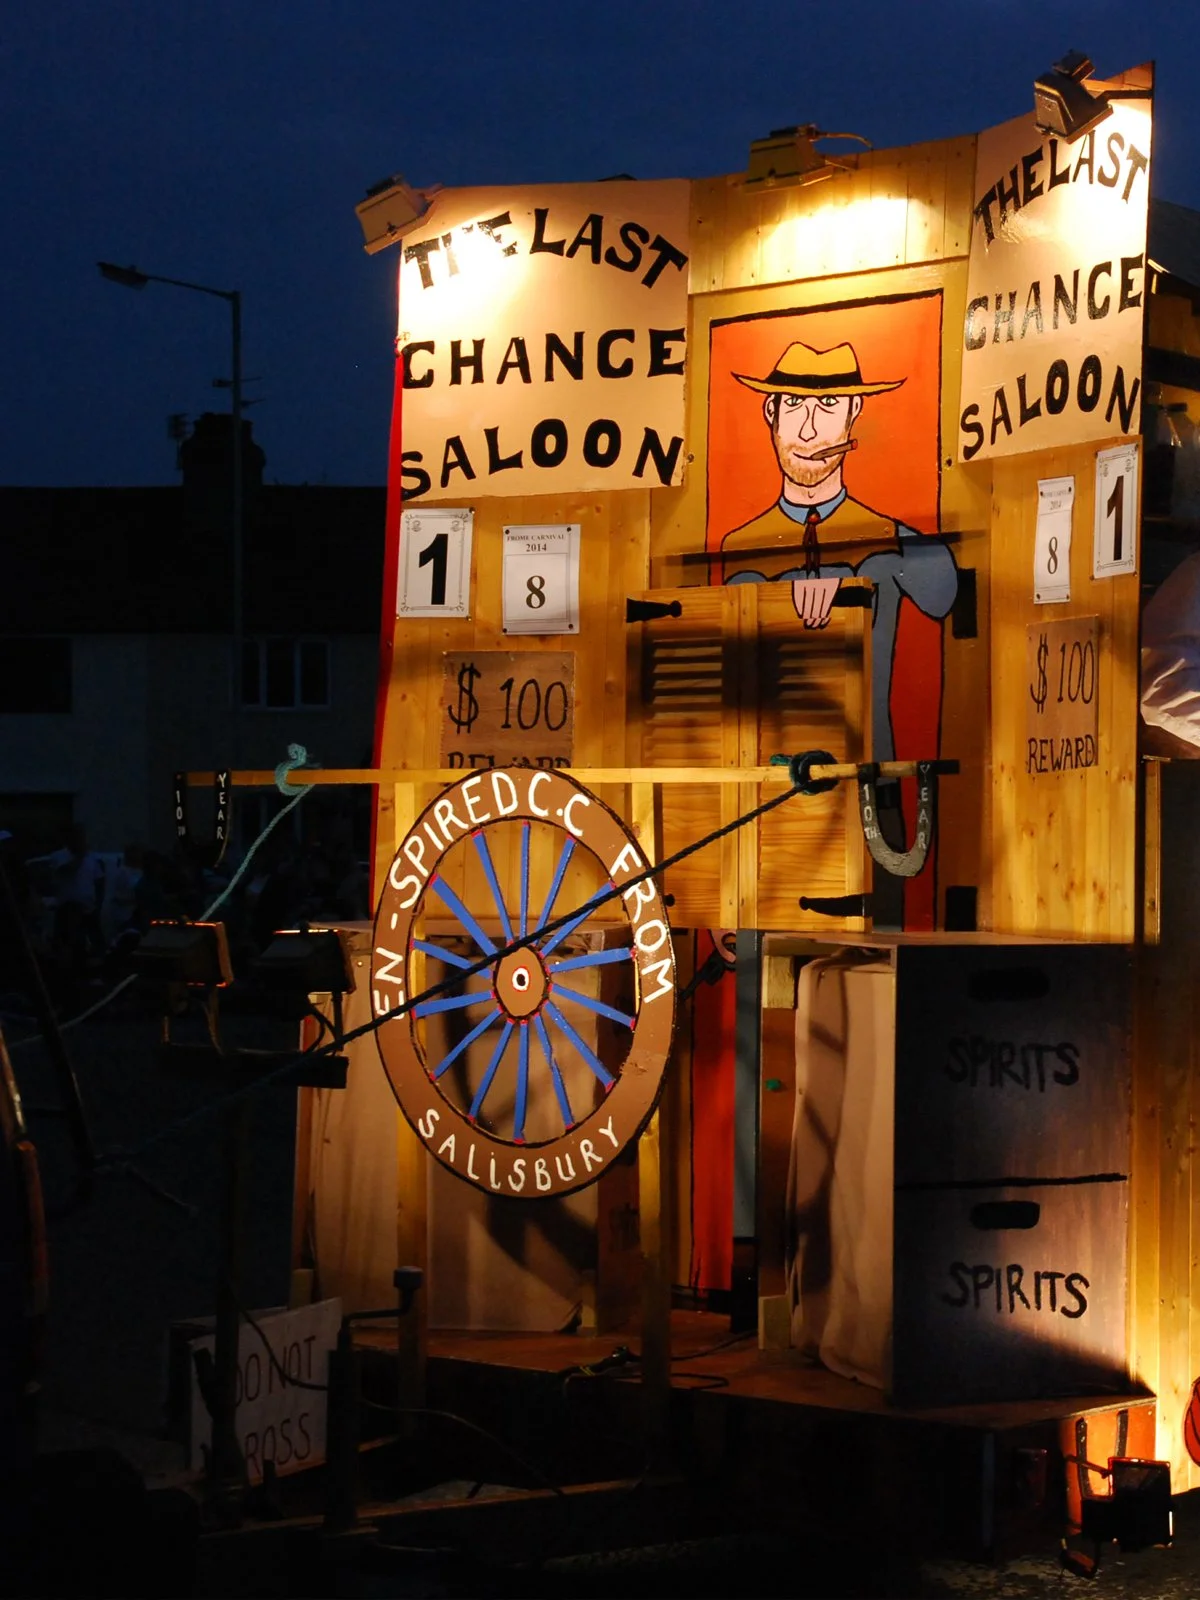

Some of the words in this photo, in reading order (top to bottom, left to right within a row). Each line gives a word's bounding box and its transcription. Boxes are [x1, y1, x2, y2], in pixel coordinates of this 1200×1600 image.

[973, 145, 1045, 247] THE
[1047, 129, 1148, 205] LAST
[529, 208, 689, 288] LAST
[964, 253, 1144, 351] CHANCE
[401, 327, 686, 389] CHANCE
[960, 354, 1140, 461] SALOON
[401, 418, 684, 501] SALOON
[525, 543, 547, 552] 2014
[1107, 475, 1124, 561] 1
[419, 533, 449, 605] 1
[1047, 536, 1058, 575] 8
[526, 575, 546, 608] 8
[499, 677, 569, 731] 100
[1057, 640, 1095, 705] 100
[1028, 734, 1096, 774] REWARD
[216, 771, 228, 841] YEAR
[917, 762, 931, 851] YEAR
[943, 1035, 1081, 1093] SPIRITS
[942, 1261, 1090, 1319] SPIRITS
[268, 1335, 316, 1395] NOT
[244, 1412, 311, 1476] ROSS
